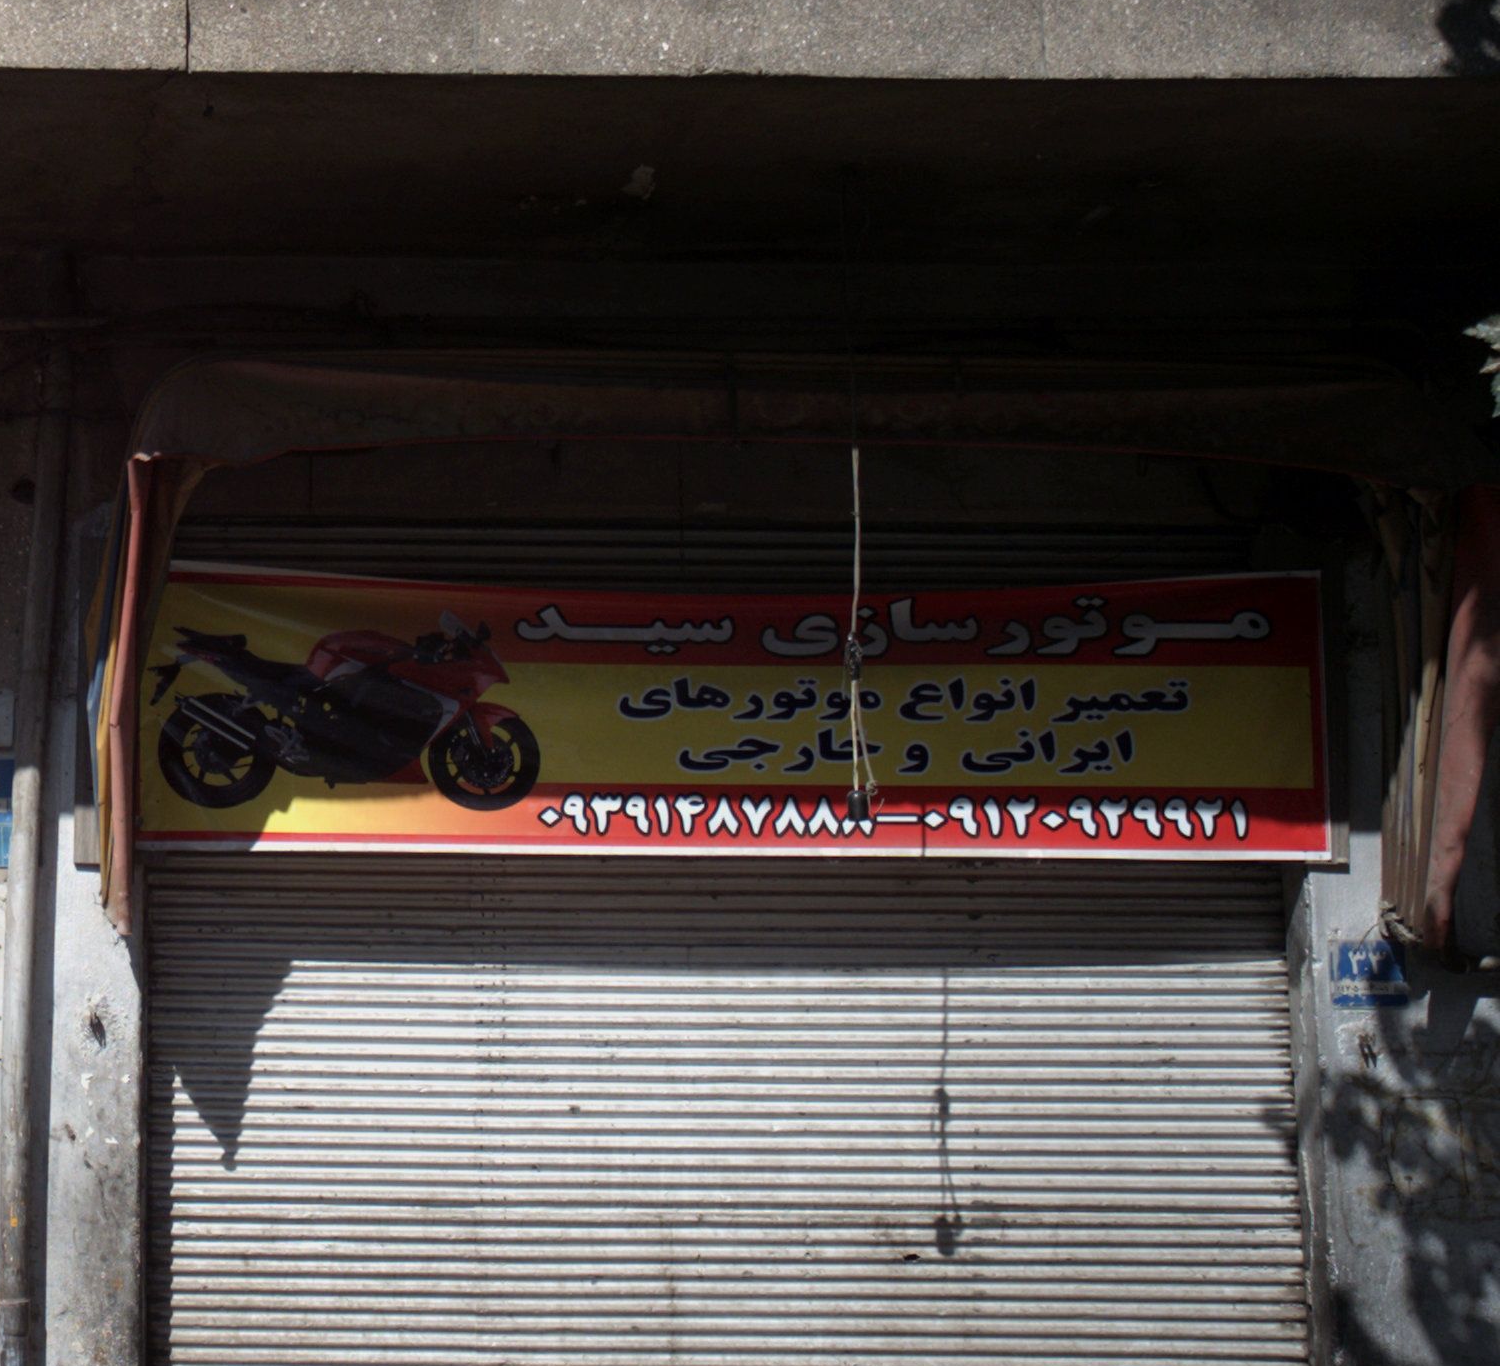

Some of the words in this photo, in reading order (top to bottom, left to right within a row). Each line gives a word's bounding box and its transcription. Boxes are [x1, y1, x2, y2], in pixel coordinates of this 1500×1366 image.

[514, 603, 735, 656] سید
[617, 676, 882, 722] موتورهای
[898, 676, 1037, 722] انواع
[1050, 678, 1190, 722] تعمیر
[676, 727, 882, 774] خارجی
[896, 740, 932, 774] و
[961, 728, 1135, 775] ایرانی
